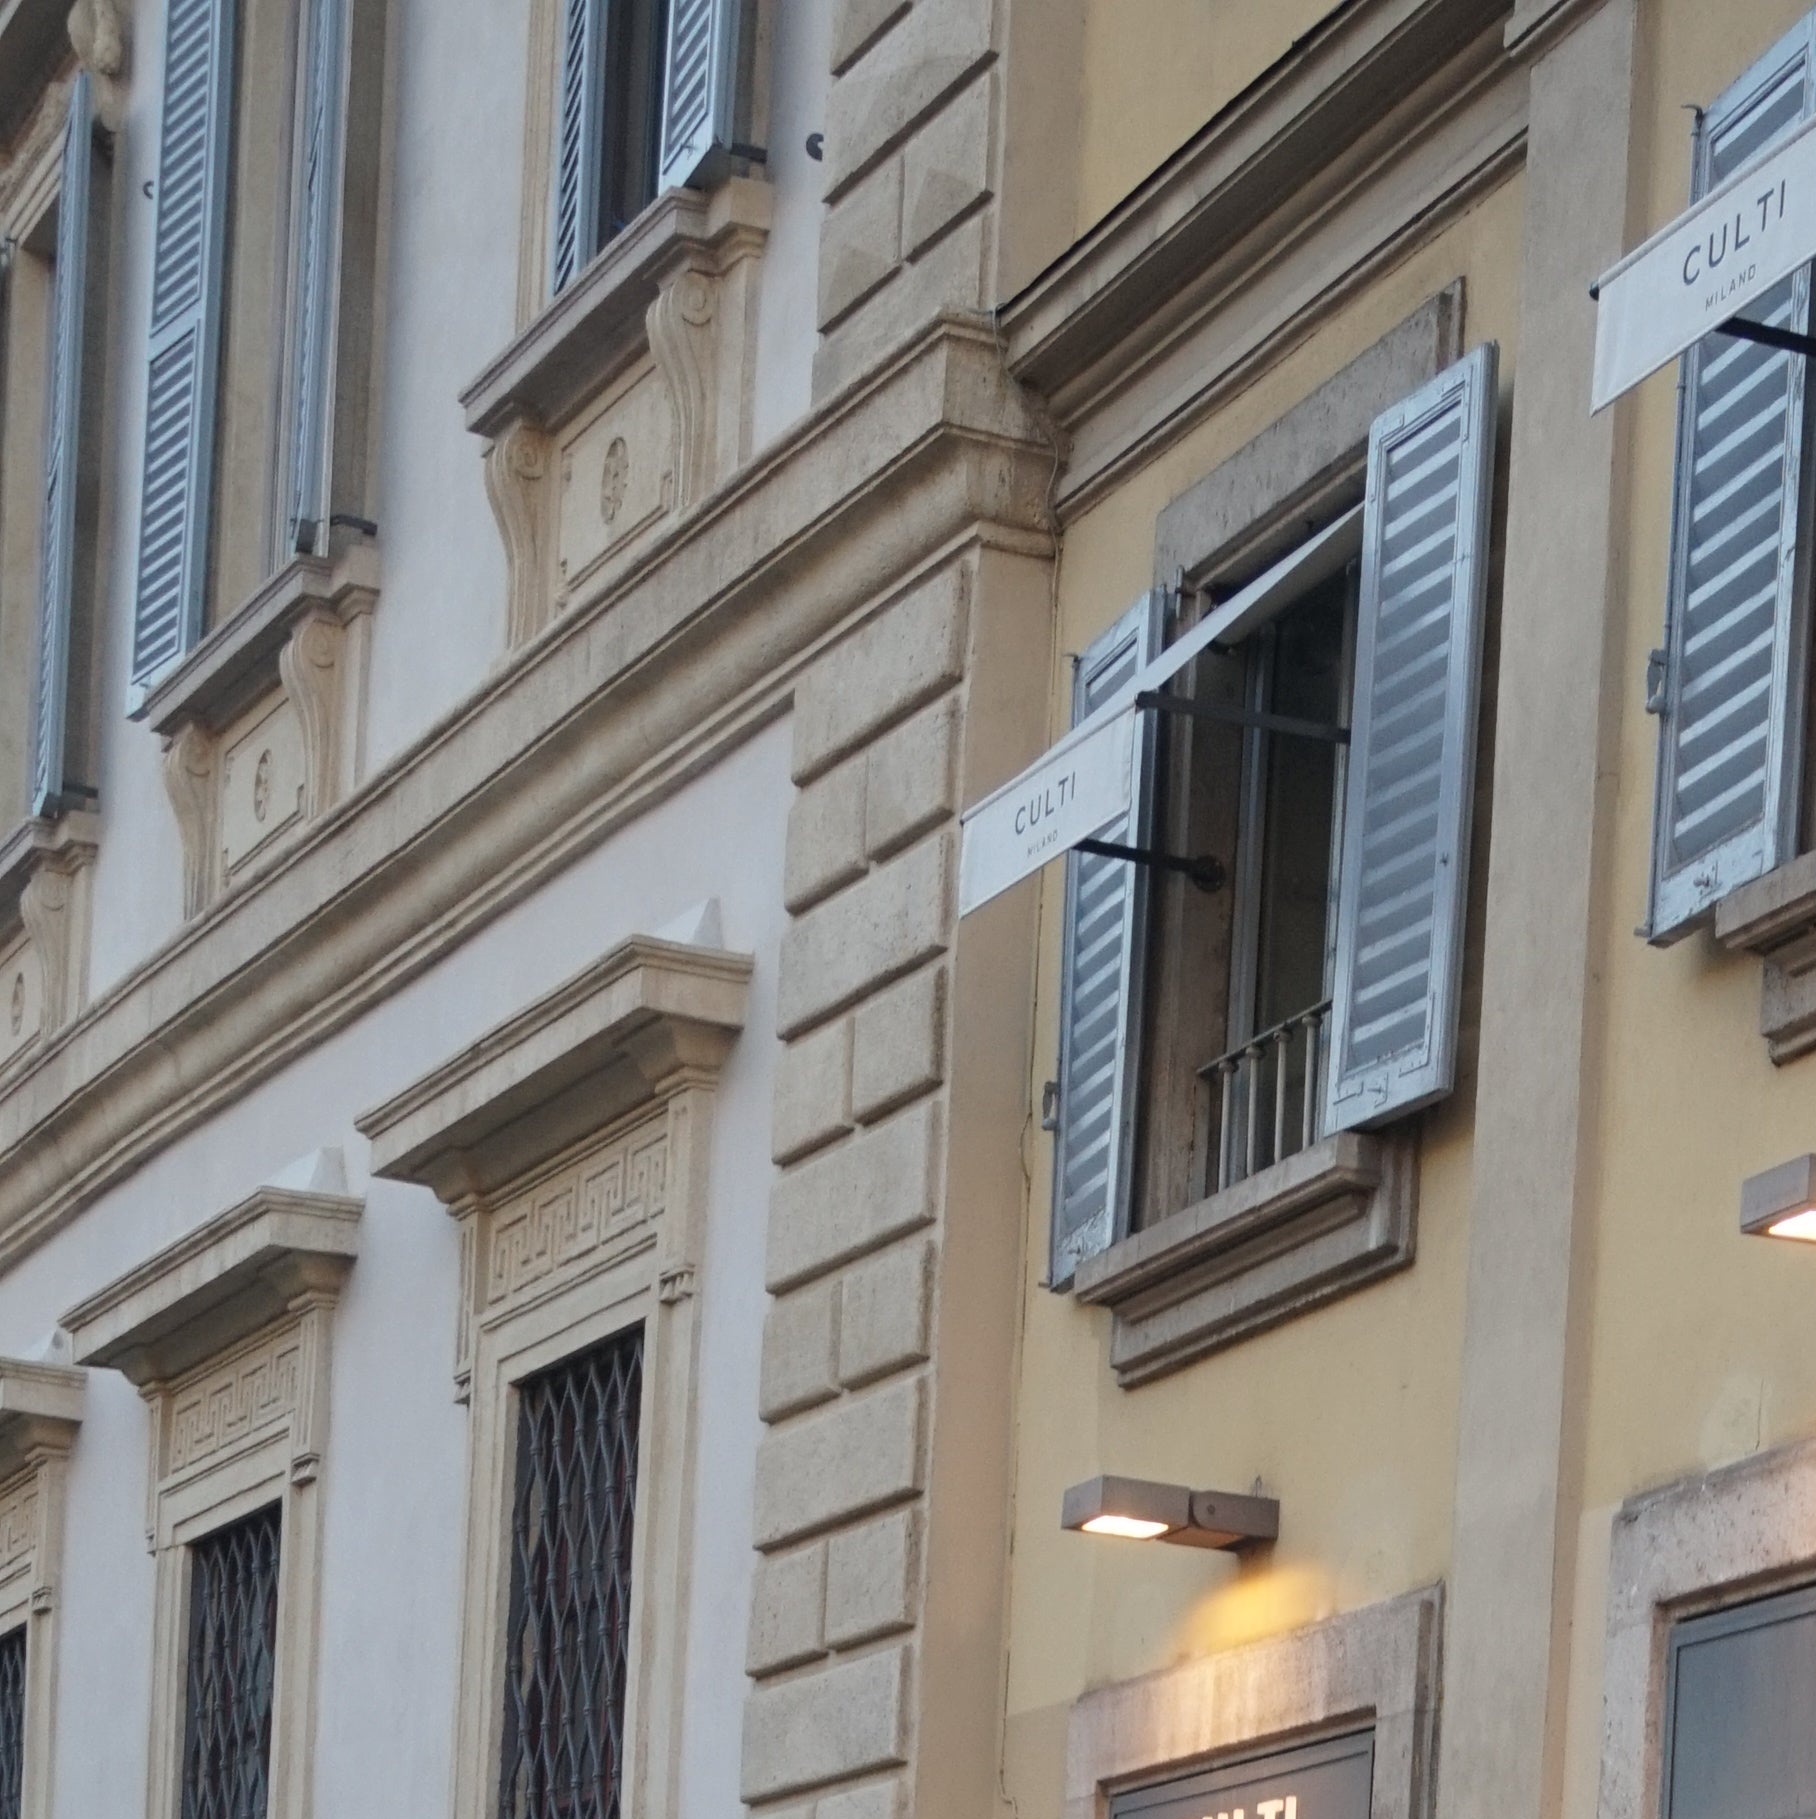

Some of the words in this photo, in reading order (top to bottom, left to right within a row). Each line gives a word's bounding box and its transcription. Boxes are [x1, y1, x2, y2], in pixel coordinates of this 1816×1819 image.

[1683, 179, 1785, 286] CULTI
[1705, 263, 1757, 312] MILANO
[1015, 771, 1076, 835] CULTI
[1027, 829, 1058, 857] MILANO
